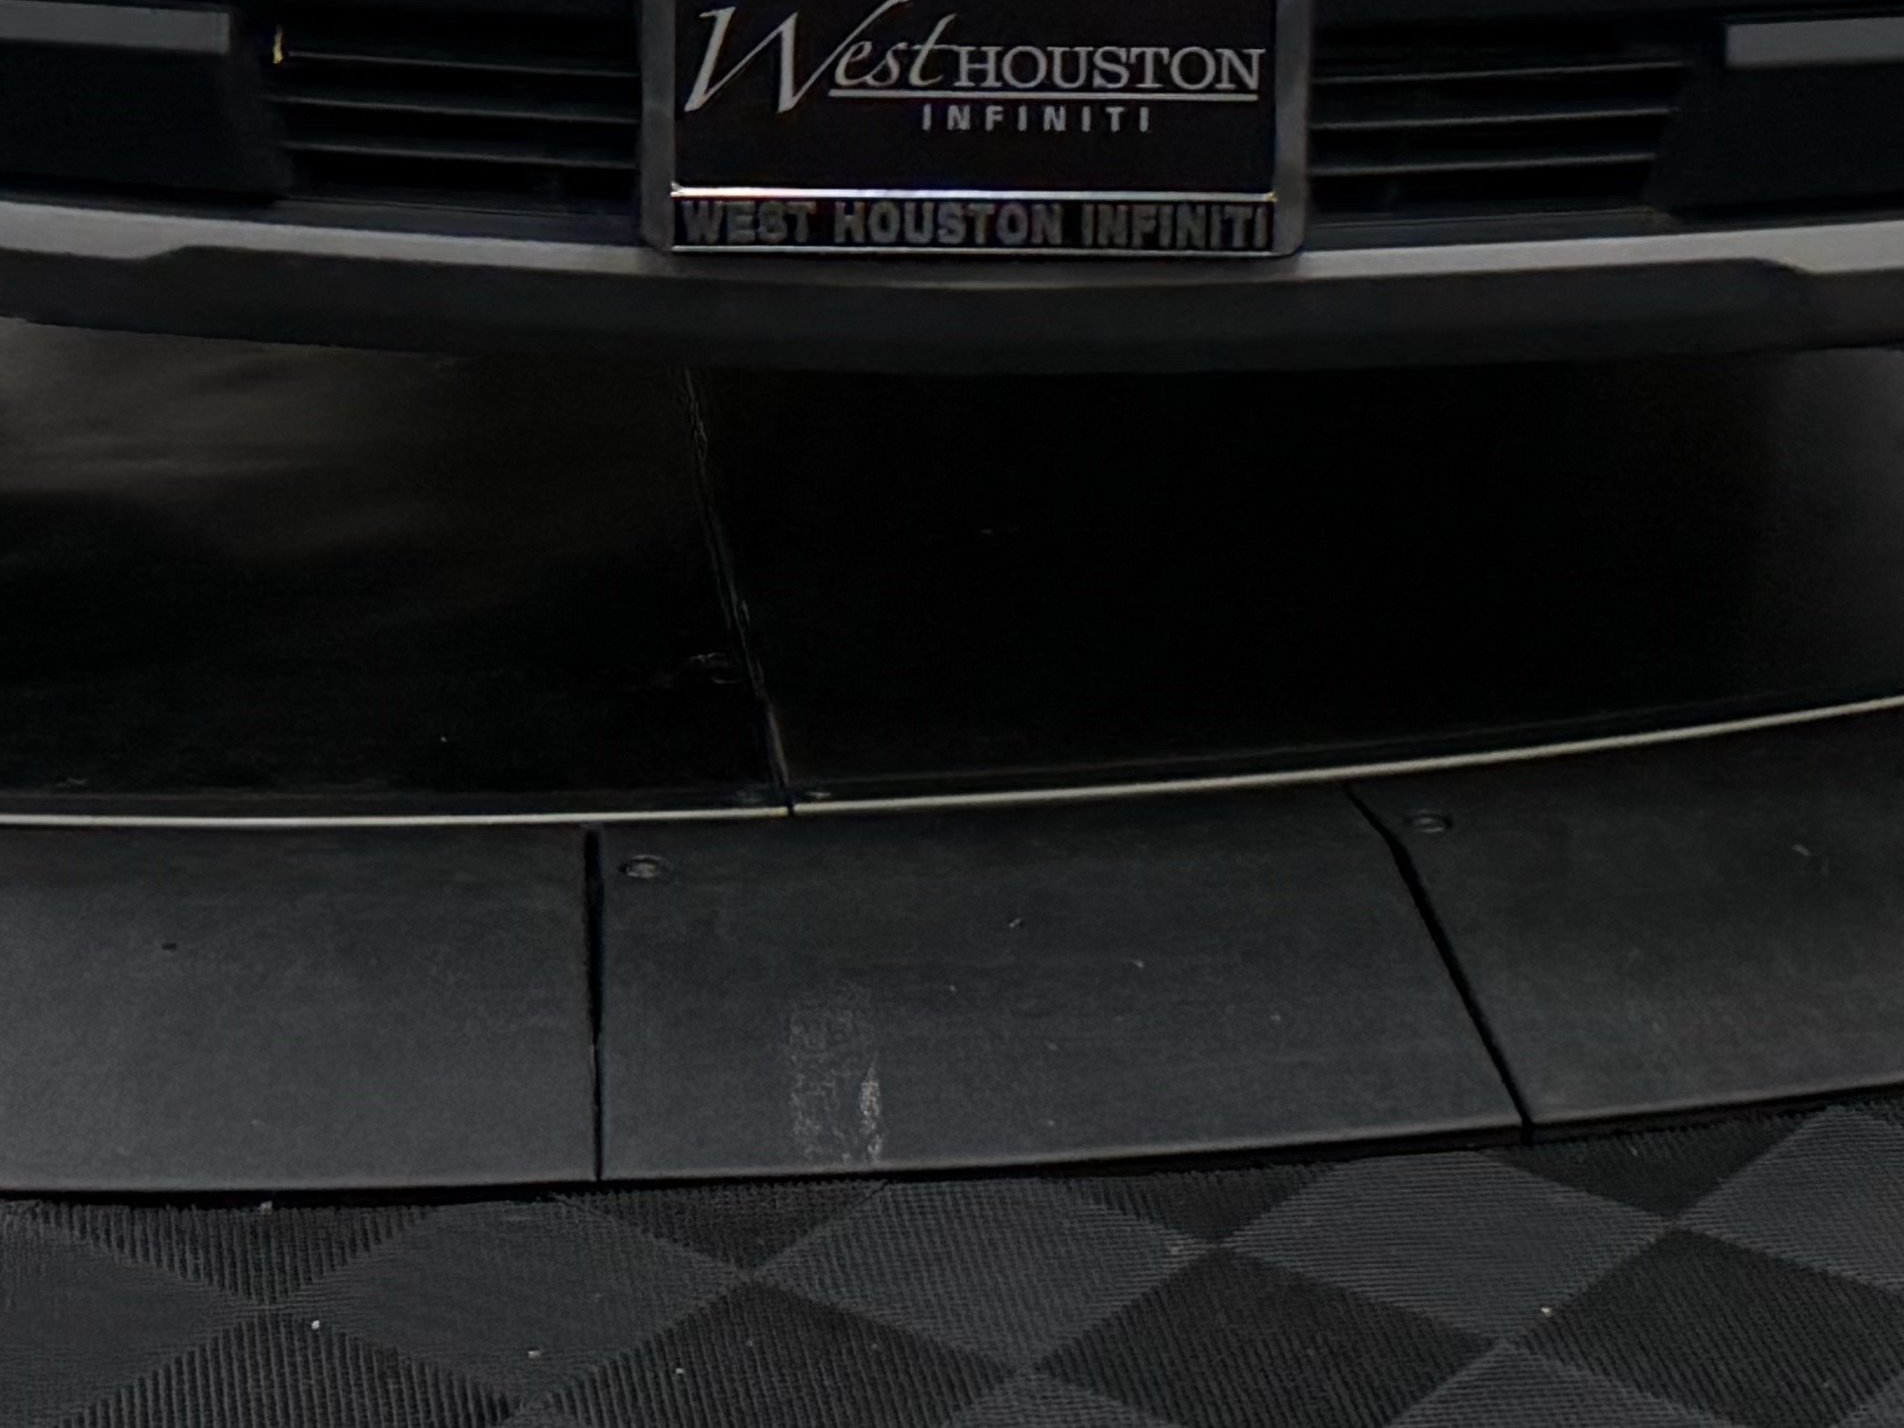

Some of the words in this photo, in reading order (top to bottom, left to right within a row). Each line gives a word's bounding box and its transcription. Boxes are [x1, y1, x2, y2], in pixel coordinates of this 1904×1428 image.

[956, 45, 1266, 92] HOUSTON
[922, 103, 1152, 133] INFINITI
[682, 200, 817, 247] WEST
[834, 201, 1063, 248] HOUSTON
[1081, 202, 1270, 250] INFINITI
